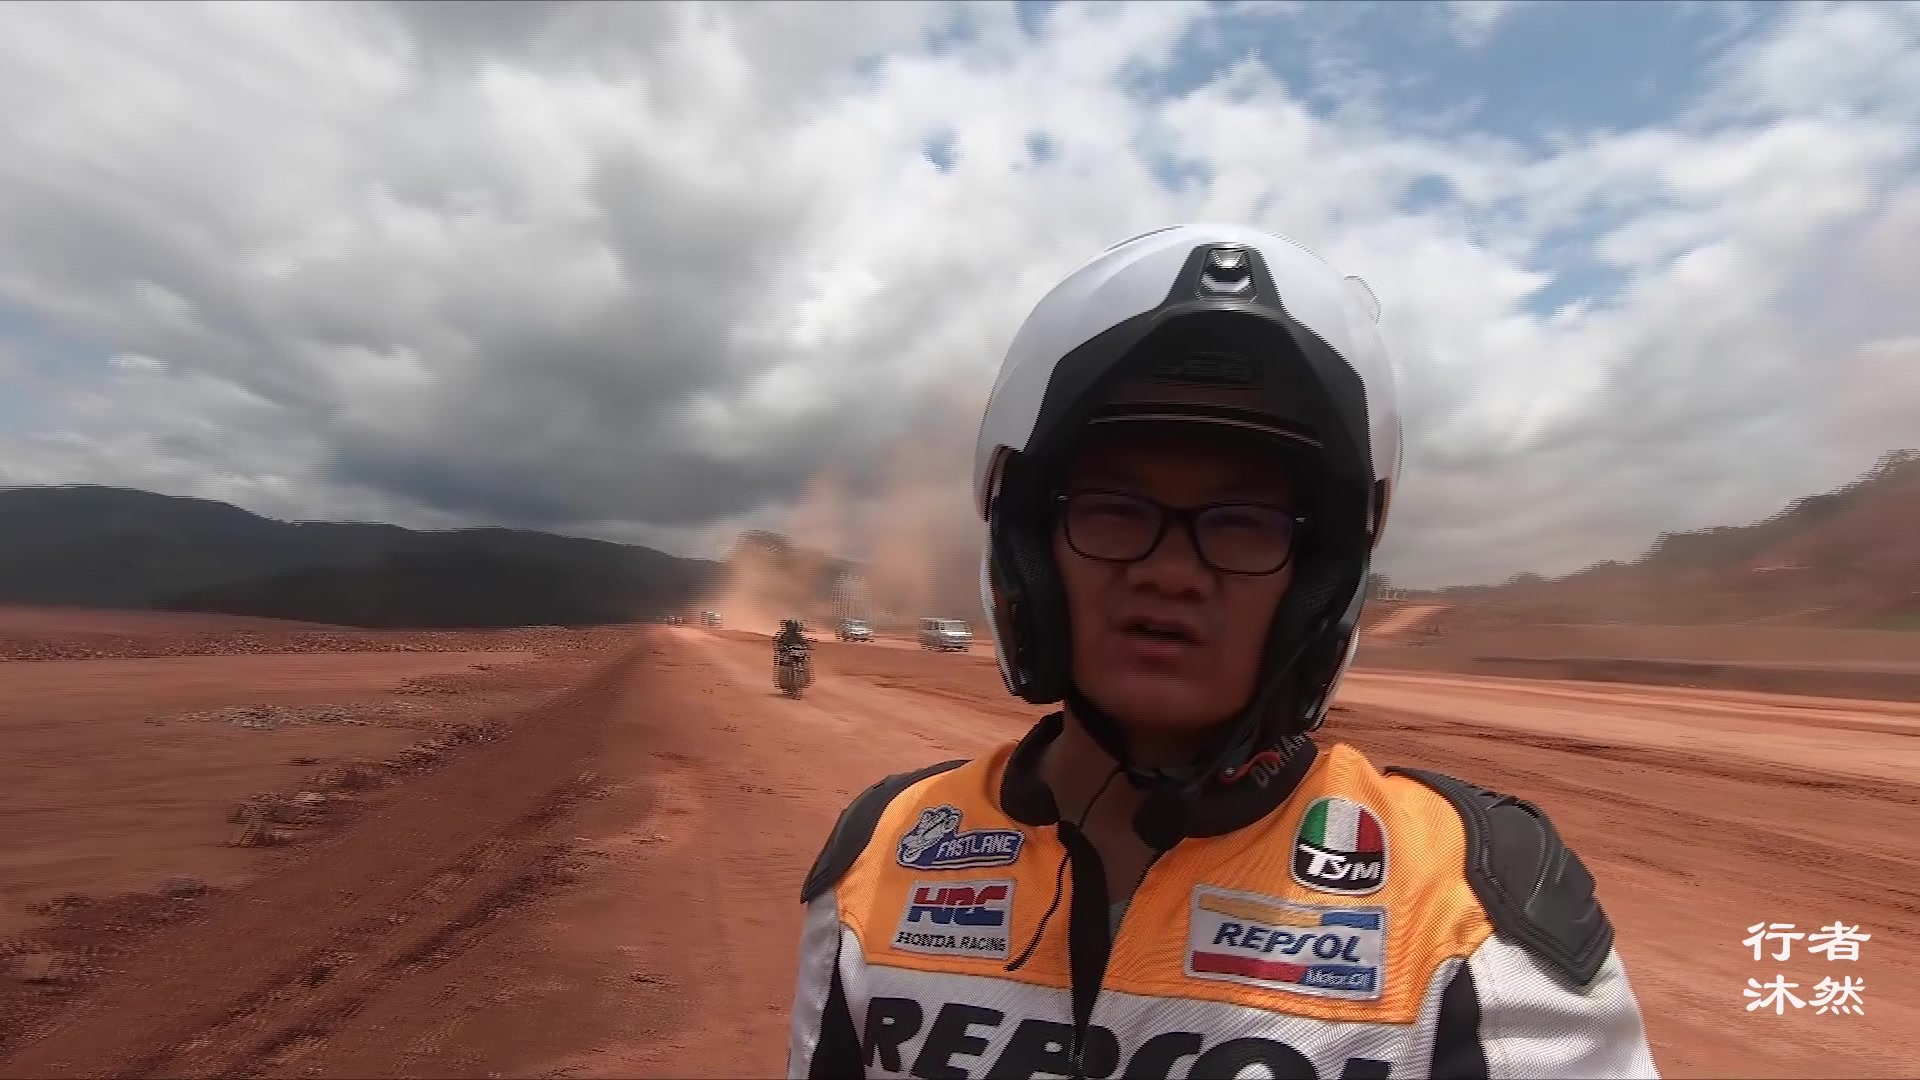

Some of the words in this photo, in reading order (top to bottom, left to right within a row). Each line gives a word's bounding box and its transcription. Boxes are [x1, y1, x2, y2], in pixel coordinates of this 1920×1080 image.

[936, 835, 1014, 859] FASTLANE
[907, 886, 1008, 926] HRC
[896, 931, 956, 949] HONDA
[959, 935, 1006, 951] RACING
[1213, 922, 1361, 962] REPSOL
[863, 998, 1393, 1080] REPSO
